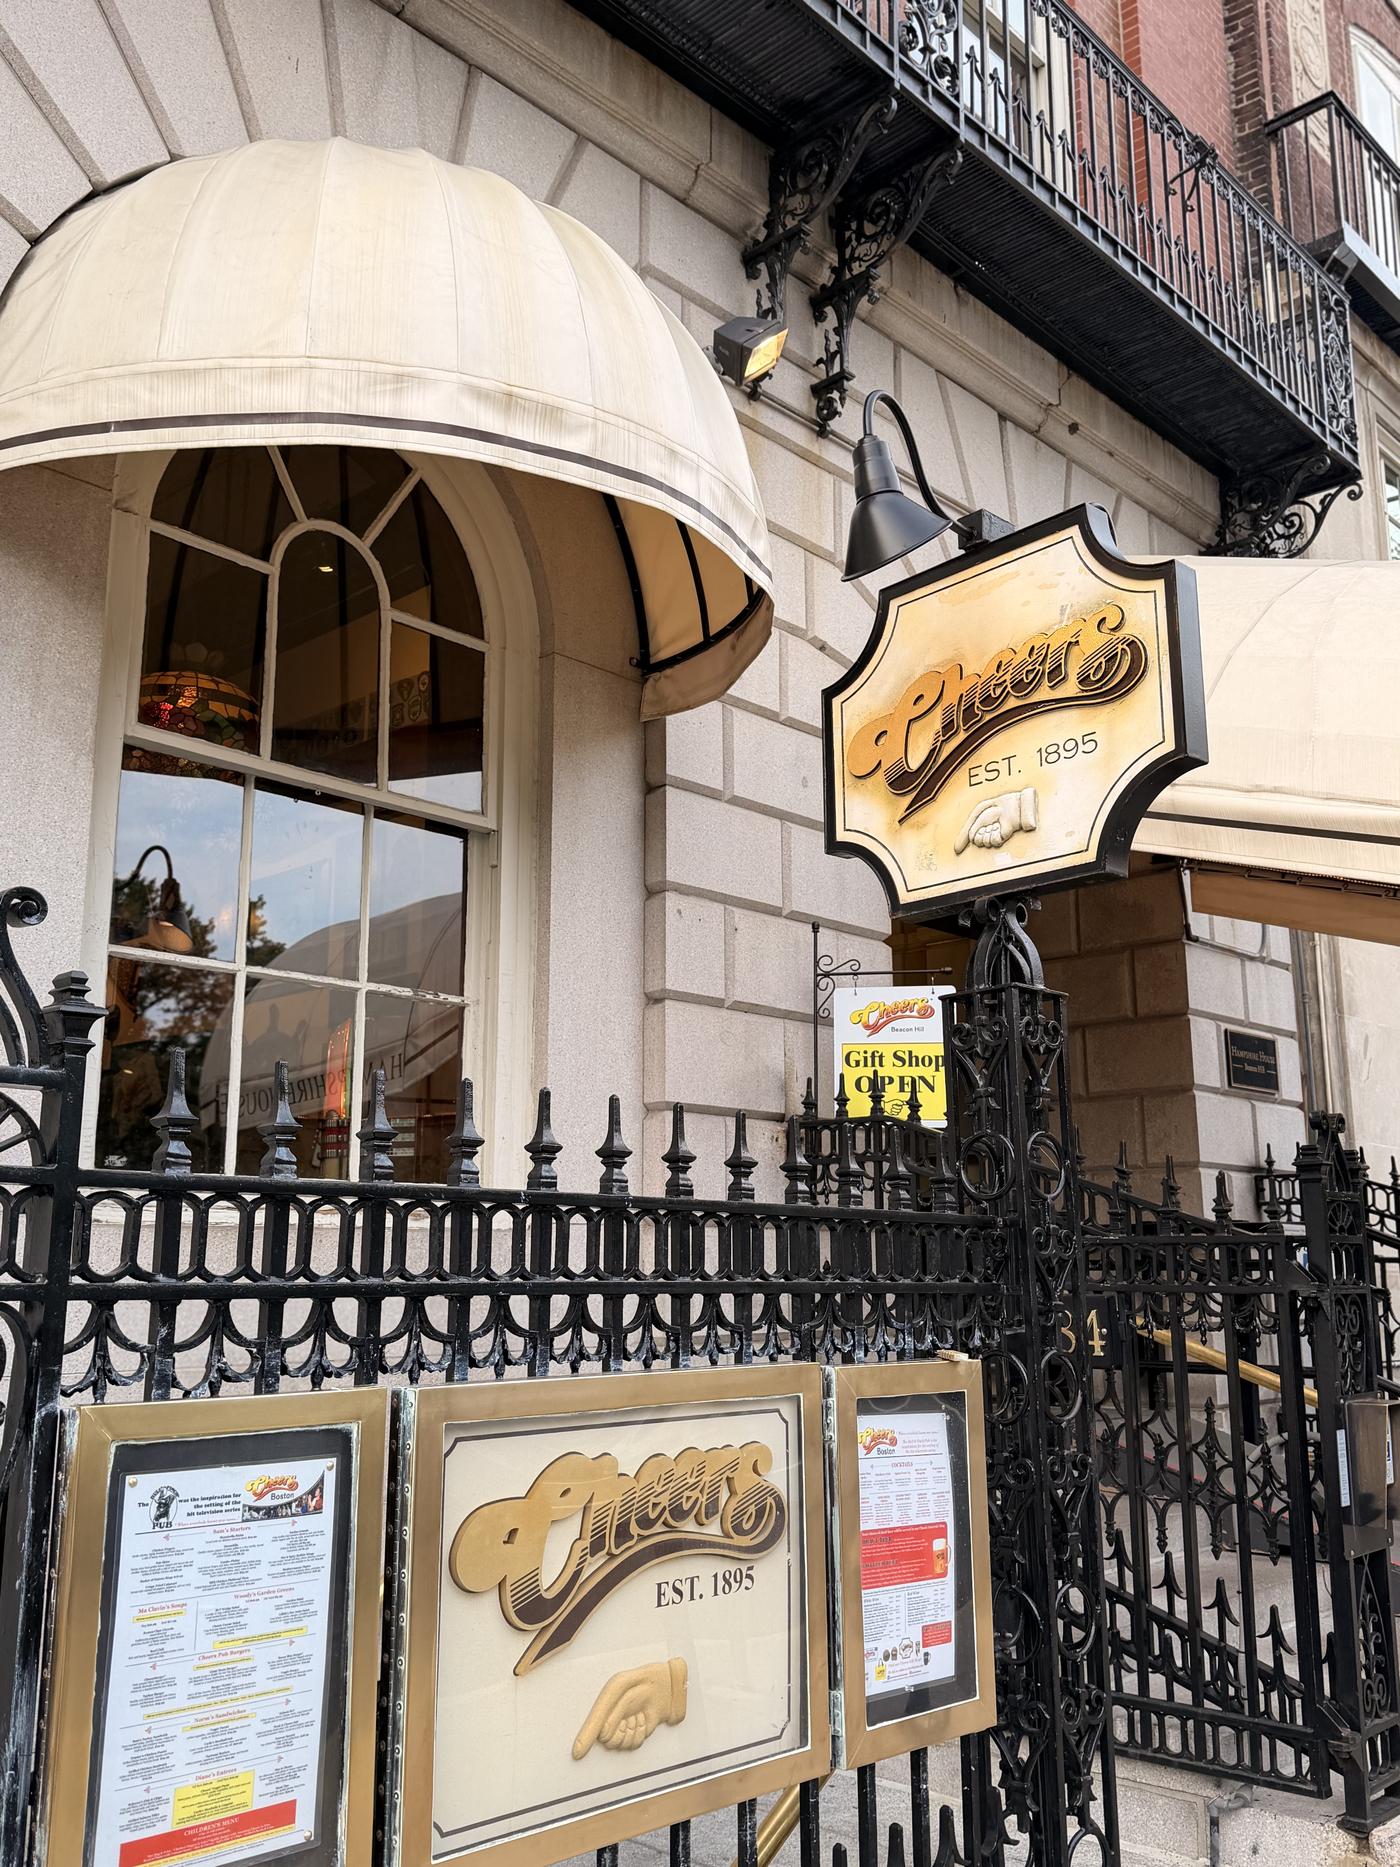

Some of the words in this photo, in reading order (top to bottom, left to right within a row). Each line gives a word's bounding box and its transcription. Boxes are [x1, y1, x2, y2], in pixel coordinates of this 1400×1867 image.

[846, 602, 1149, 825] Cheers
[967, 753, 1022, 788] EST.
[1036, 731, 1099, 768] 1895
[849, 996, 936, 1038] Cheers
[914, 1025, 925, 1033] Hill
[844, 1049, 886, 1069] Gift
[854, 1074, 937, 1094] OPEN
[876, 1447, 896, 1456] Boston
[271, 1492, 295, 1501] Boston
[152, 1521, 173, 1530] PUB
[448, 1440, 787, 1677] Cheers
[654, 1575, 704, 1609] EST.
[710, 1565, 756, 1599] 1895
